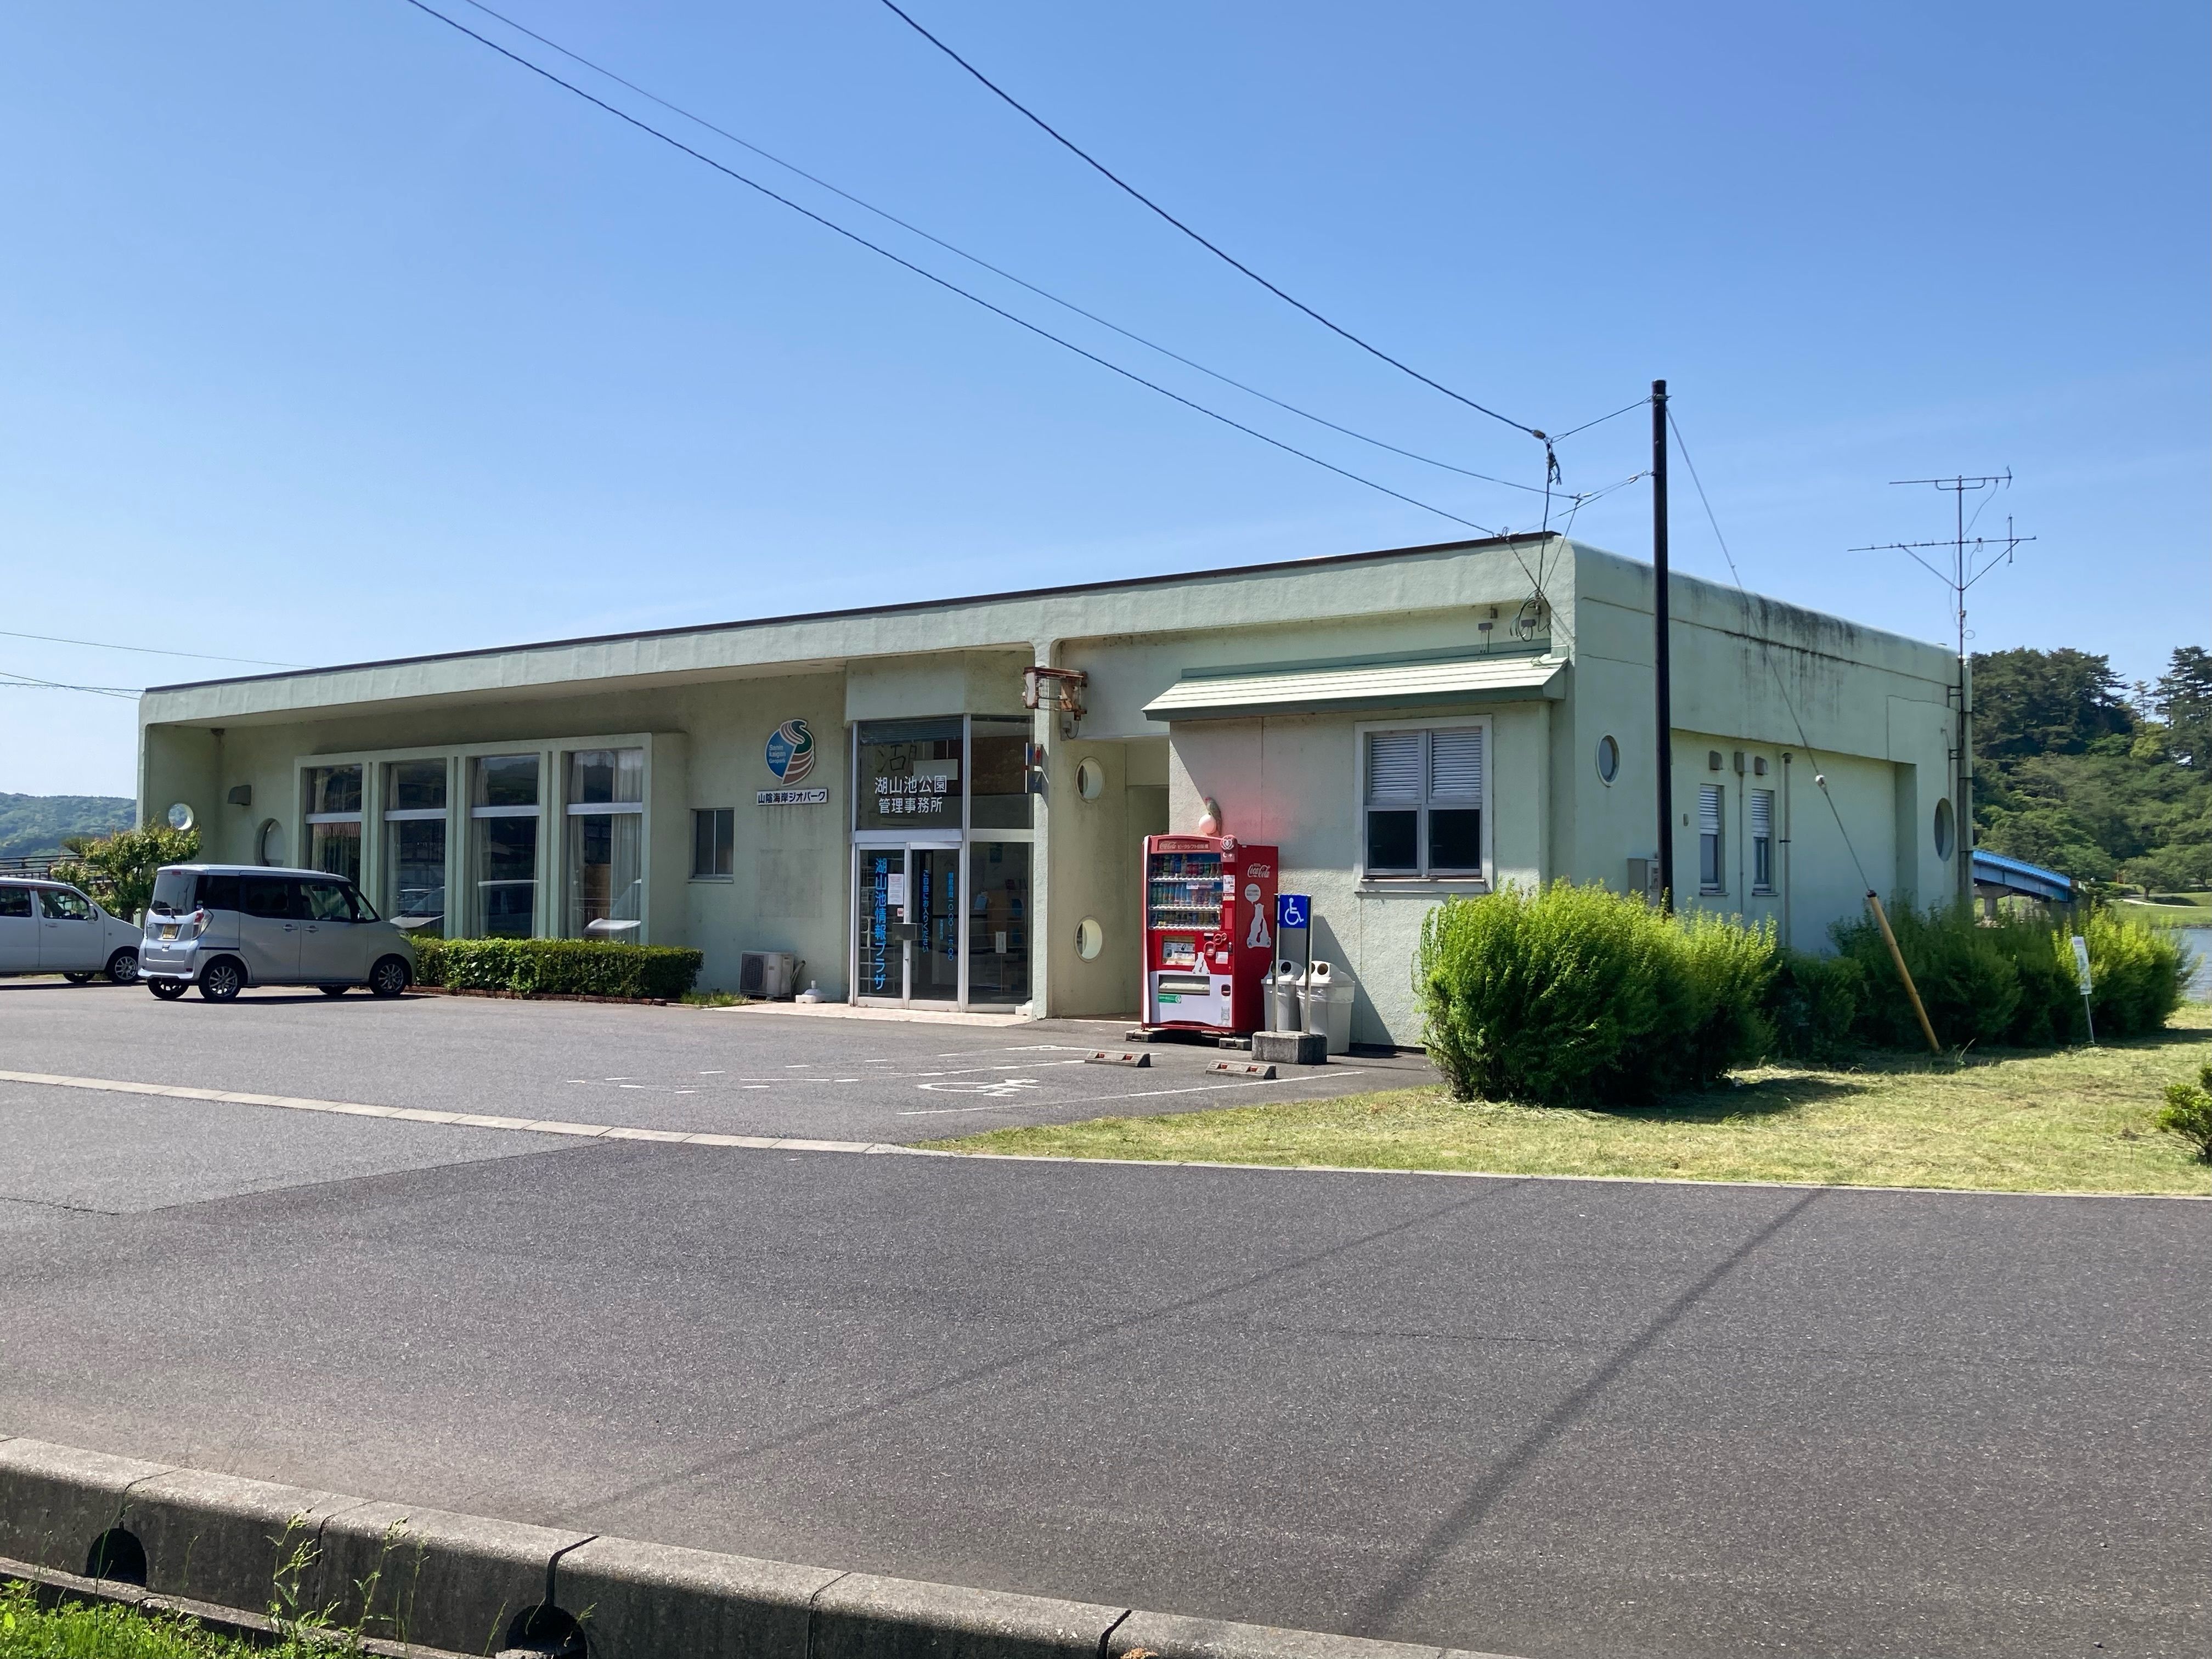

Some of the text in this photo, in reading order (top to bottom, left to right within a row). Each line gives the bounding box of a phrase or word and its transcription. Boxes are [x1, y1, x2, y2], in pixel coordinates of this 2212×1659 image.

[874, 775, 947, 794] 湖山池公園
[758, 791, 825, 804] 山陰海岸ジオパーク
[879, 797, 943, 814] 管理事務所
[874, 857, 887, 990] 湖山池情報プラザ
